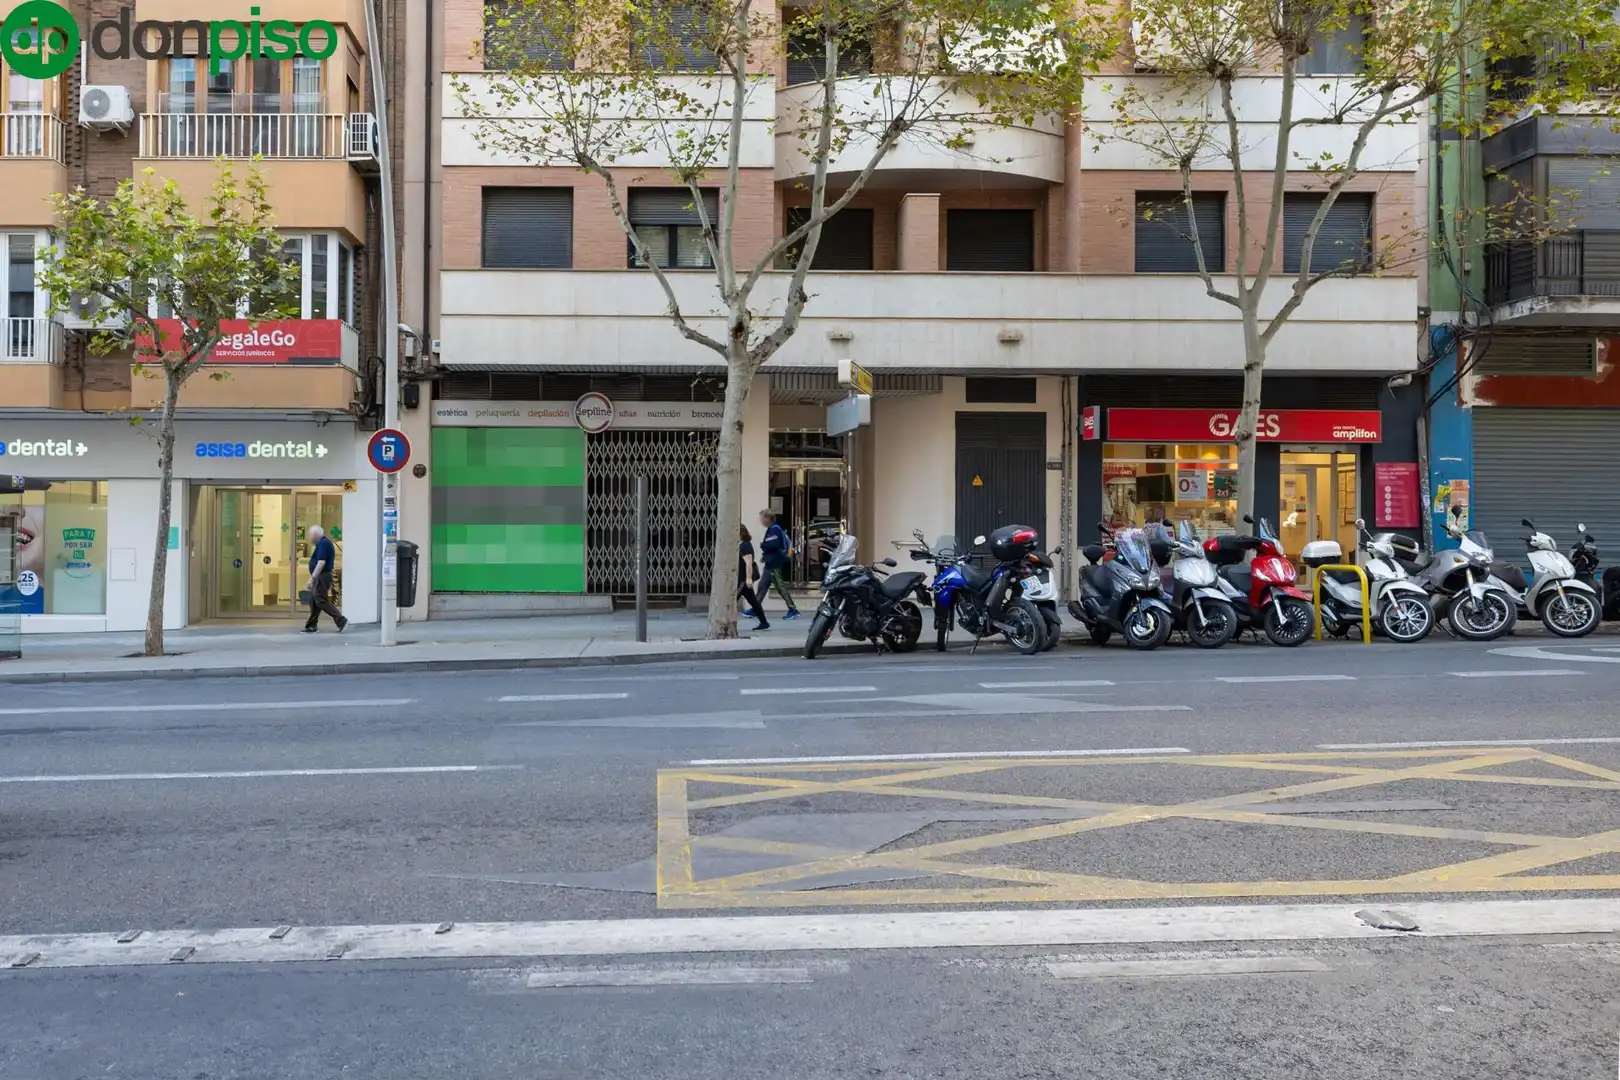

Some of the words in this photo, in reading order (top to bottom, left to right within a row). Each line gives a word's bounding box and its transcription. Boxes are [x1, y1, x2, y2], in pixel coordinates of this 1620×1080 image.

[217, 329, 295, 350] egaleGo
[437, 408, 468, 417] estética
[475, 408, 520, 418] peluquería
[528, 408, 570, 419] depilación
[648, 409, 680, 418] nutrición
[1332, 428, 1377, 440] amplifon
[8, 438, 74, 456] dental
[195, 442, 246, 457] asisa
[247, 440, 313, 457] dental
[21, 573, 34, 583] 25
